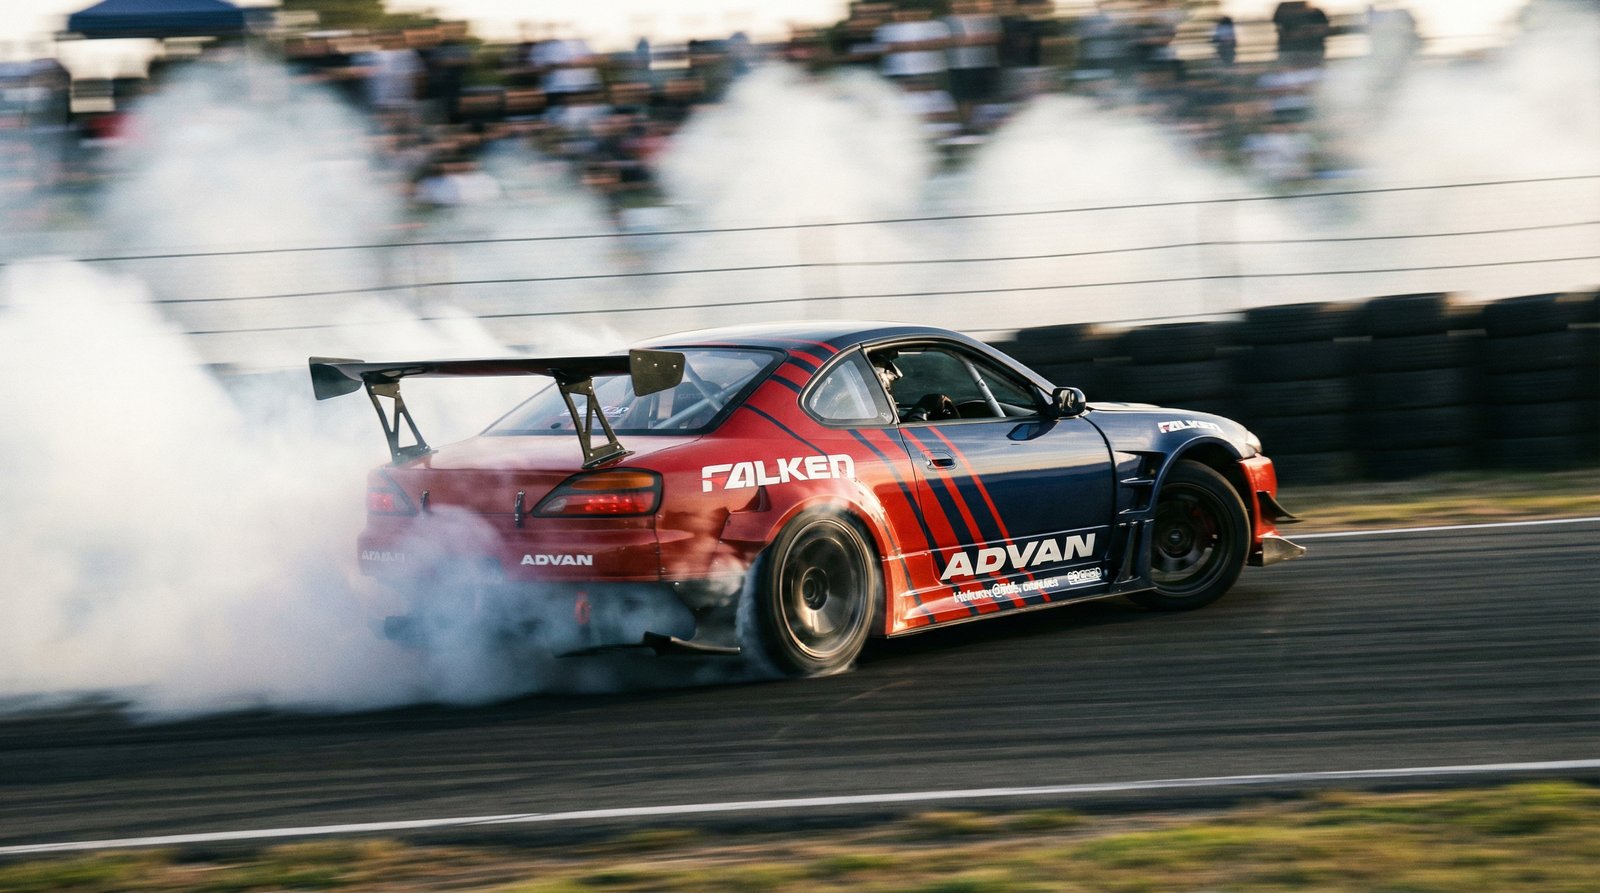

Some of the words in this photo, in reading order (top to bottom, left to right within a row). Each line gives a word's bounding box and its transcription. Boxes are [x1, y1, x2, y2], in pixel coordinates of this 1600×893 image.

[701, 454, 855, 493] FALKEN
[520, 554, 593, 566] ADVAN
[940, 533, 1096, 581] ADVAN
